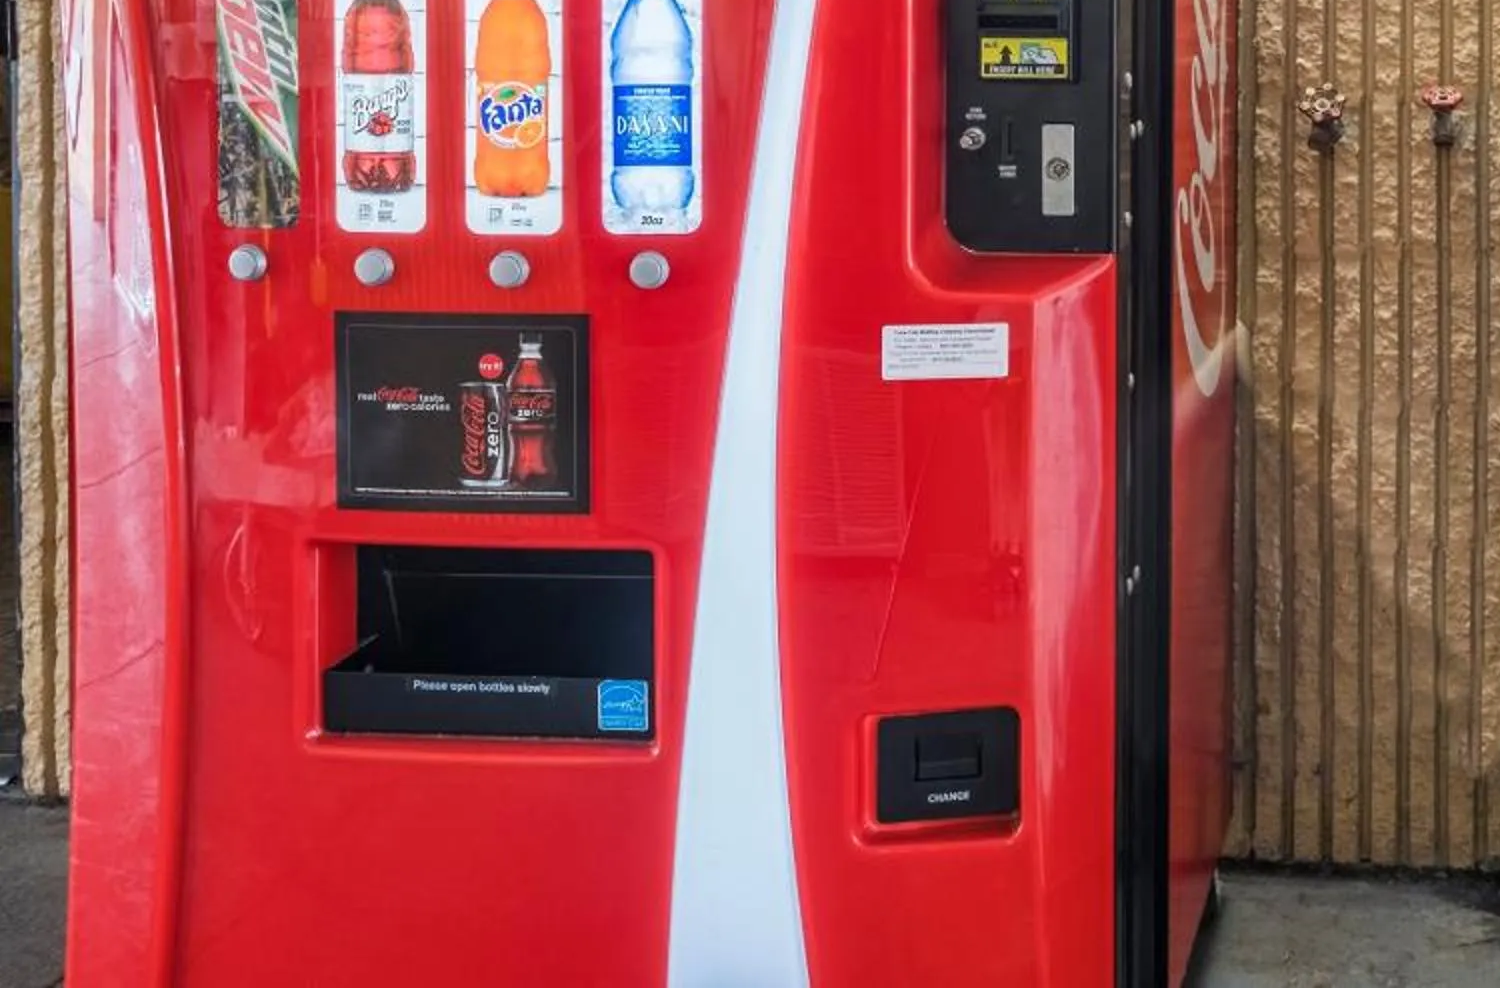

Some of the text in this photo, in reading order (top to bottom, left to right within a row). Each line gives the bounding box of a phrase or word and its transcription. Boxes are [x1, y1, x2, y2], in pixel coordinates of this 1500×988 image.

[479, 93, 543, 134] Fanta
[616, 113, 689, 136] DASANI
[487, 411, 500, 458] zero
[412, 679, 551, 696] Please open bottles slowly
[926, 789, 972, 804] CHANGE
